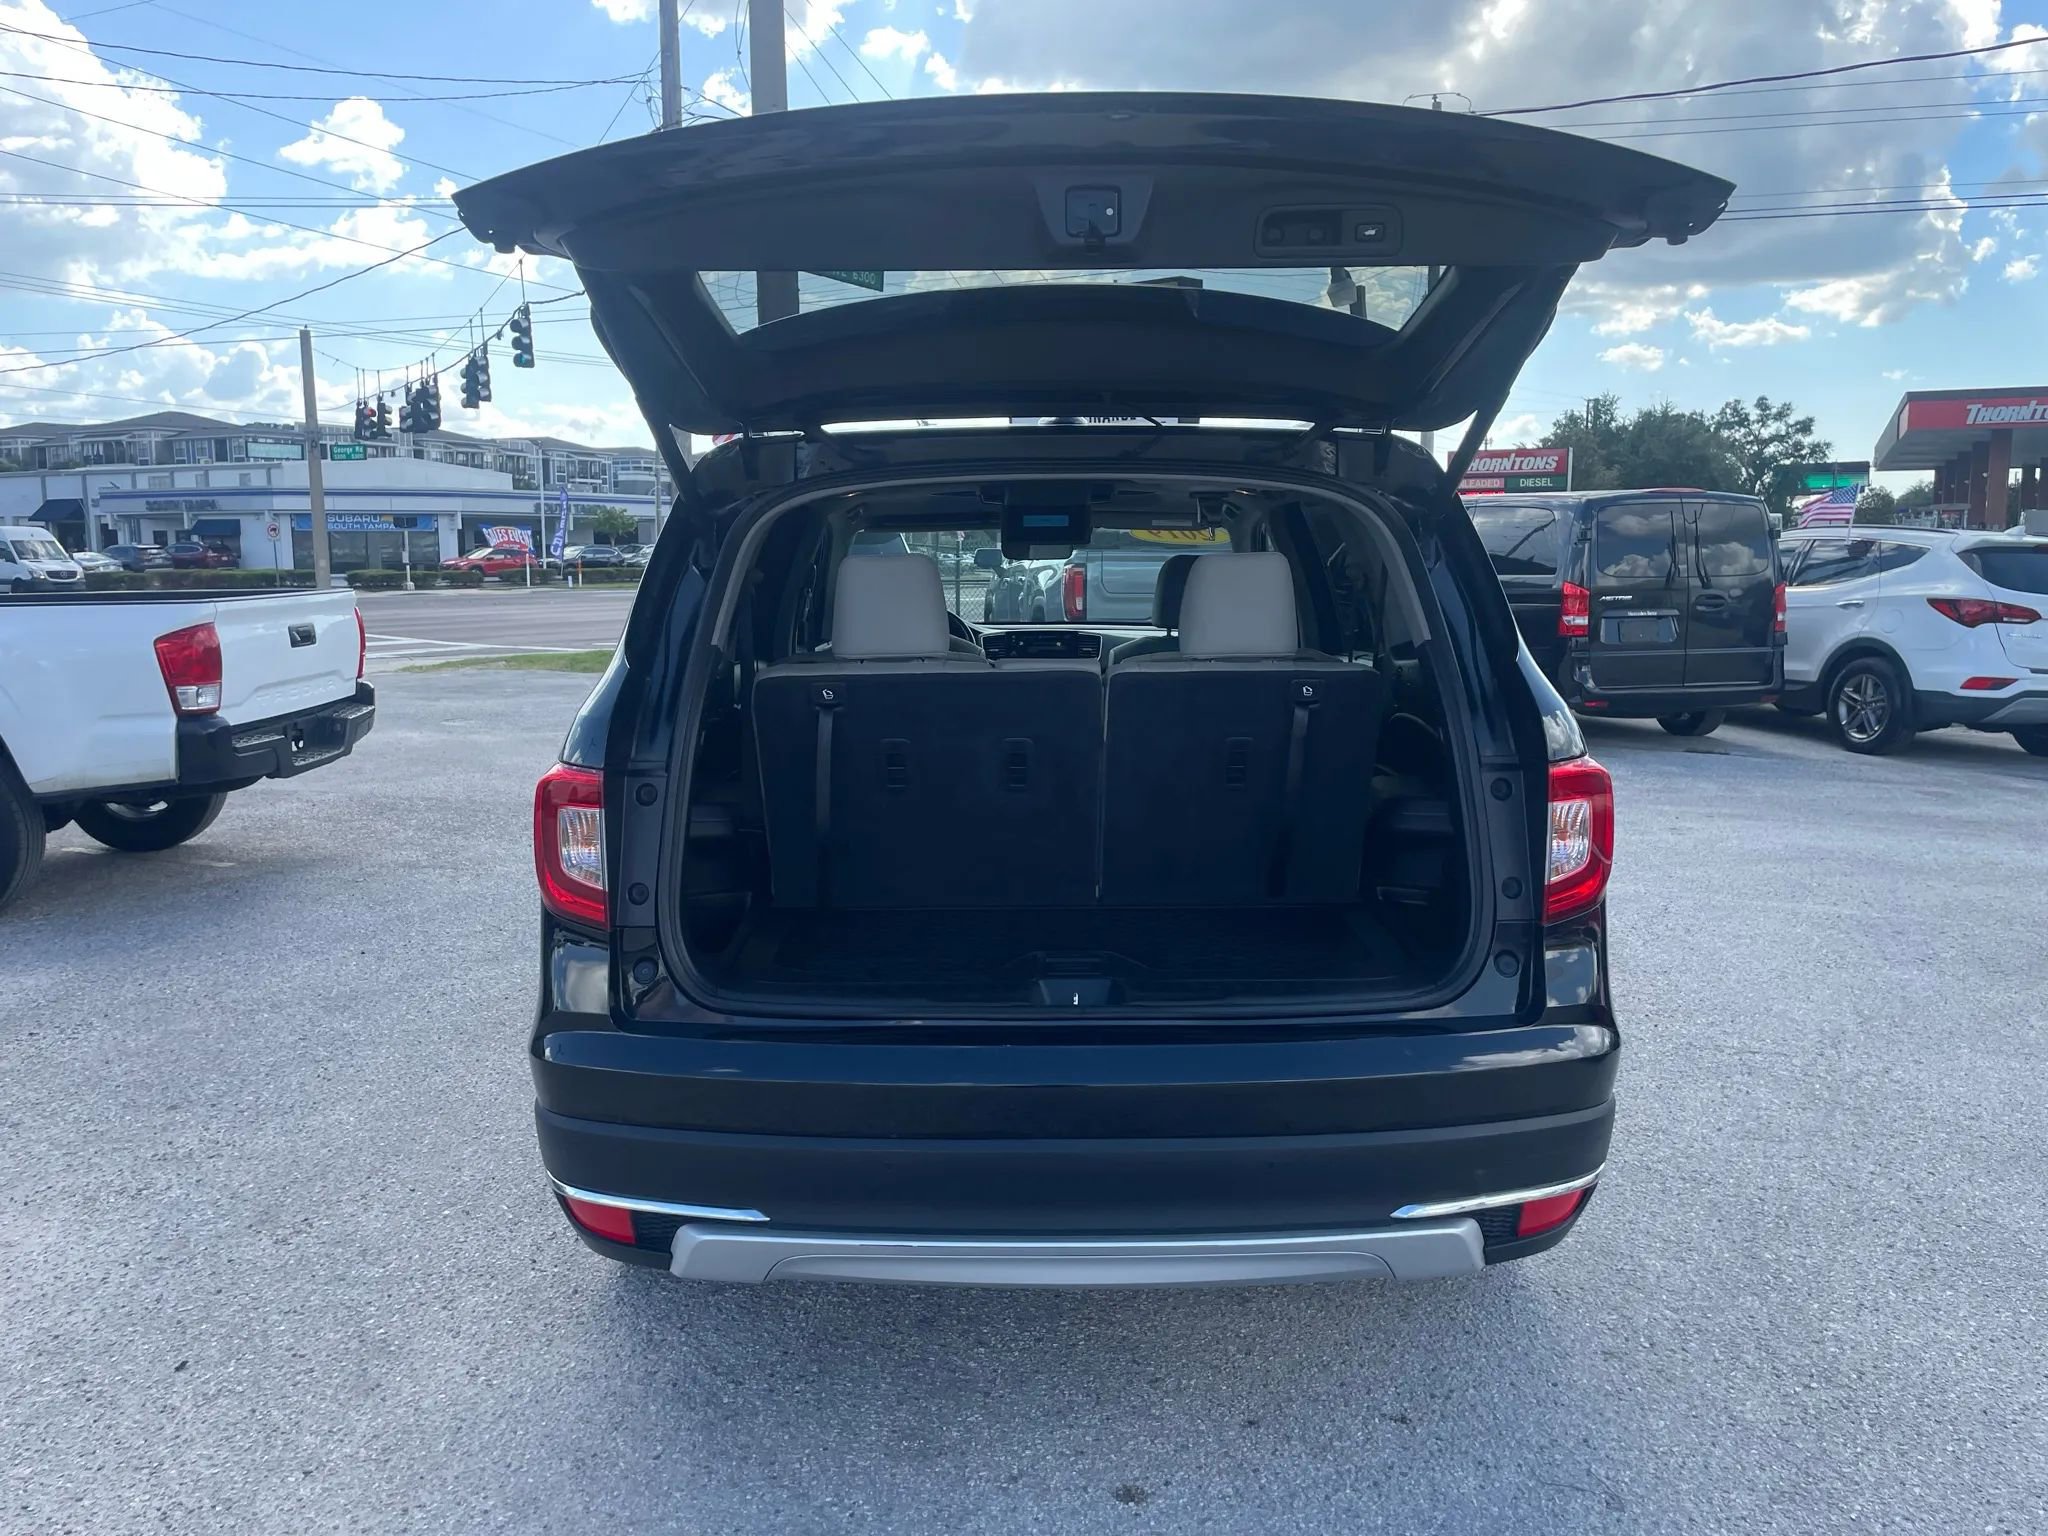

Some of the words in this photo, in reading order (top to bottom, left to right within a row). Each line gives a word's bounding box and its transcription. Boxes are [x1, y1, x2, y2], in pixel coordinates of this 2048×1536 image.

[1966, 400, 2048, 424] THORNT
[333, 447, 353, 455] George
[1467, 453, 1559, 473] HORNTONS
[1519, 478, 1553, 487] DIESEL
[327, 514, 380, 523] SUBARU
[482, 527, 508, 547] SALES
[507, 529, 534, 551] EVENT
